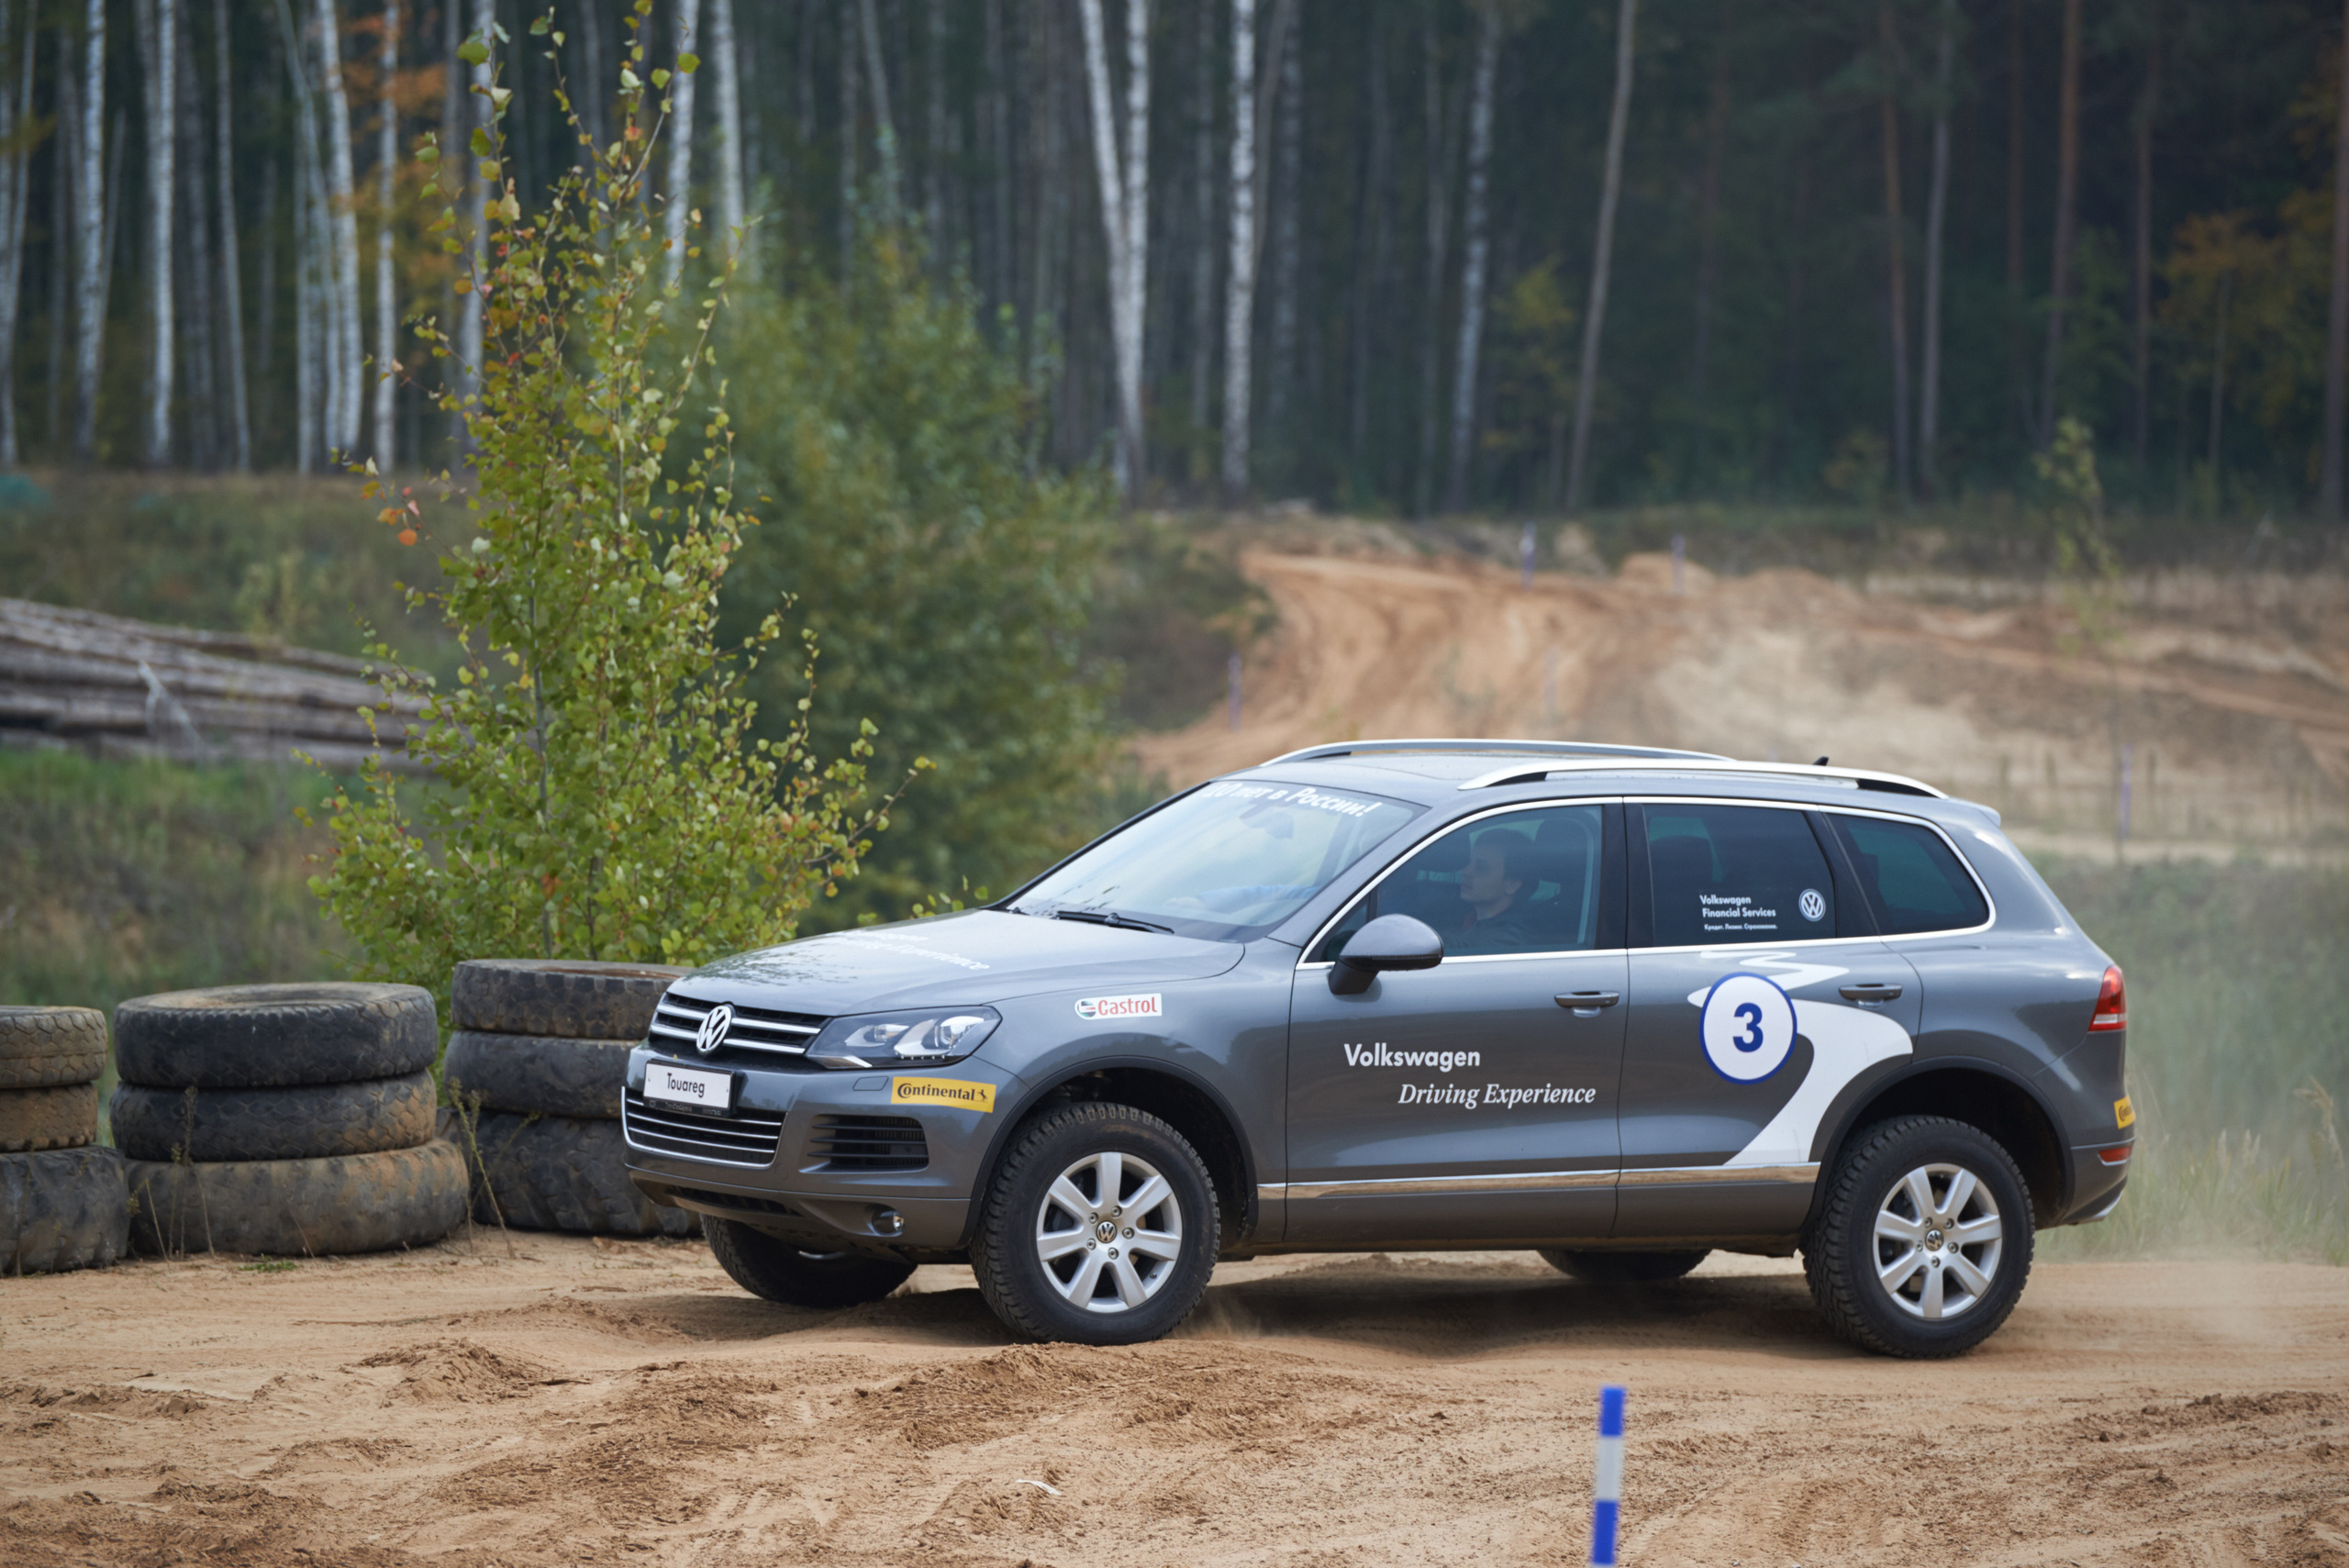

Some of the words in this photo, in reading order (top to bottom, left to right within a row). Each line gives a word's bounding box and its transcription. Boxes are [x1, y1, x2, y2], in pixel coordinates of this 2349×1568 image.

[1286, 786, 1384, 817] России!
[1699, 894, 1752, 906] Volkswagen
[1702, 907, 1741, 917] Financial
[1742, 906, 1776, 917] Services
[1097, 996, 1158, 1016] Castrol
[1732, 1001, 1764, 1053] 3
[1343, 1042, 1481, 1073] Volkswagen
[667, 1072, 706, 1099] Touareg
[896, 1083, 975, 1102] Continental
[1397, 1083, 1481, 1110] Driving
[1482, 1083, 1597, 1109] Experience
